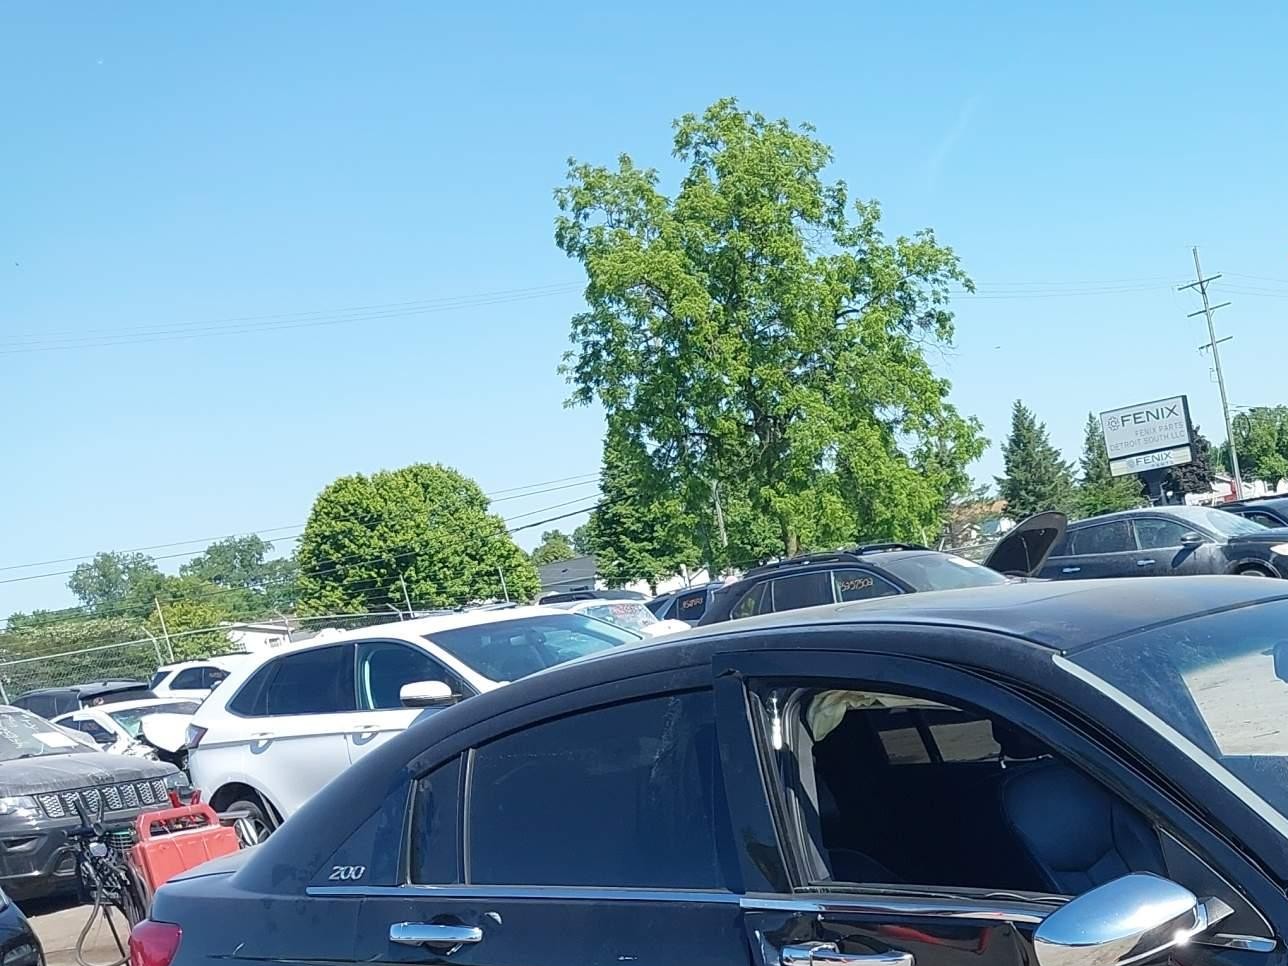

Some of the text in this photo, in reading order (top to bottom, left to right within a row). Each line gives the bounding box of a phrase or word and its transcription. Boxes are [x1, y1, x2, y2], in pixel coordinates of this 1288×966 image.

[1120, 405, 1178, 427] FENIX
[1135, 422, 1184, 436] FENIX PARTS
[1110, 431, 1185, 451] DETROIT SOUTH LLC
[1136, 452, 1173, 466] FENIX
[328, 865, 366, 880] 200
